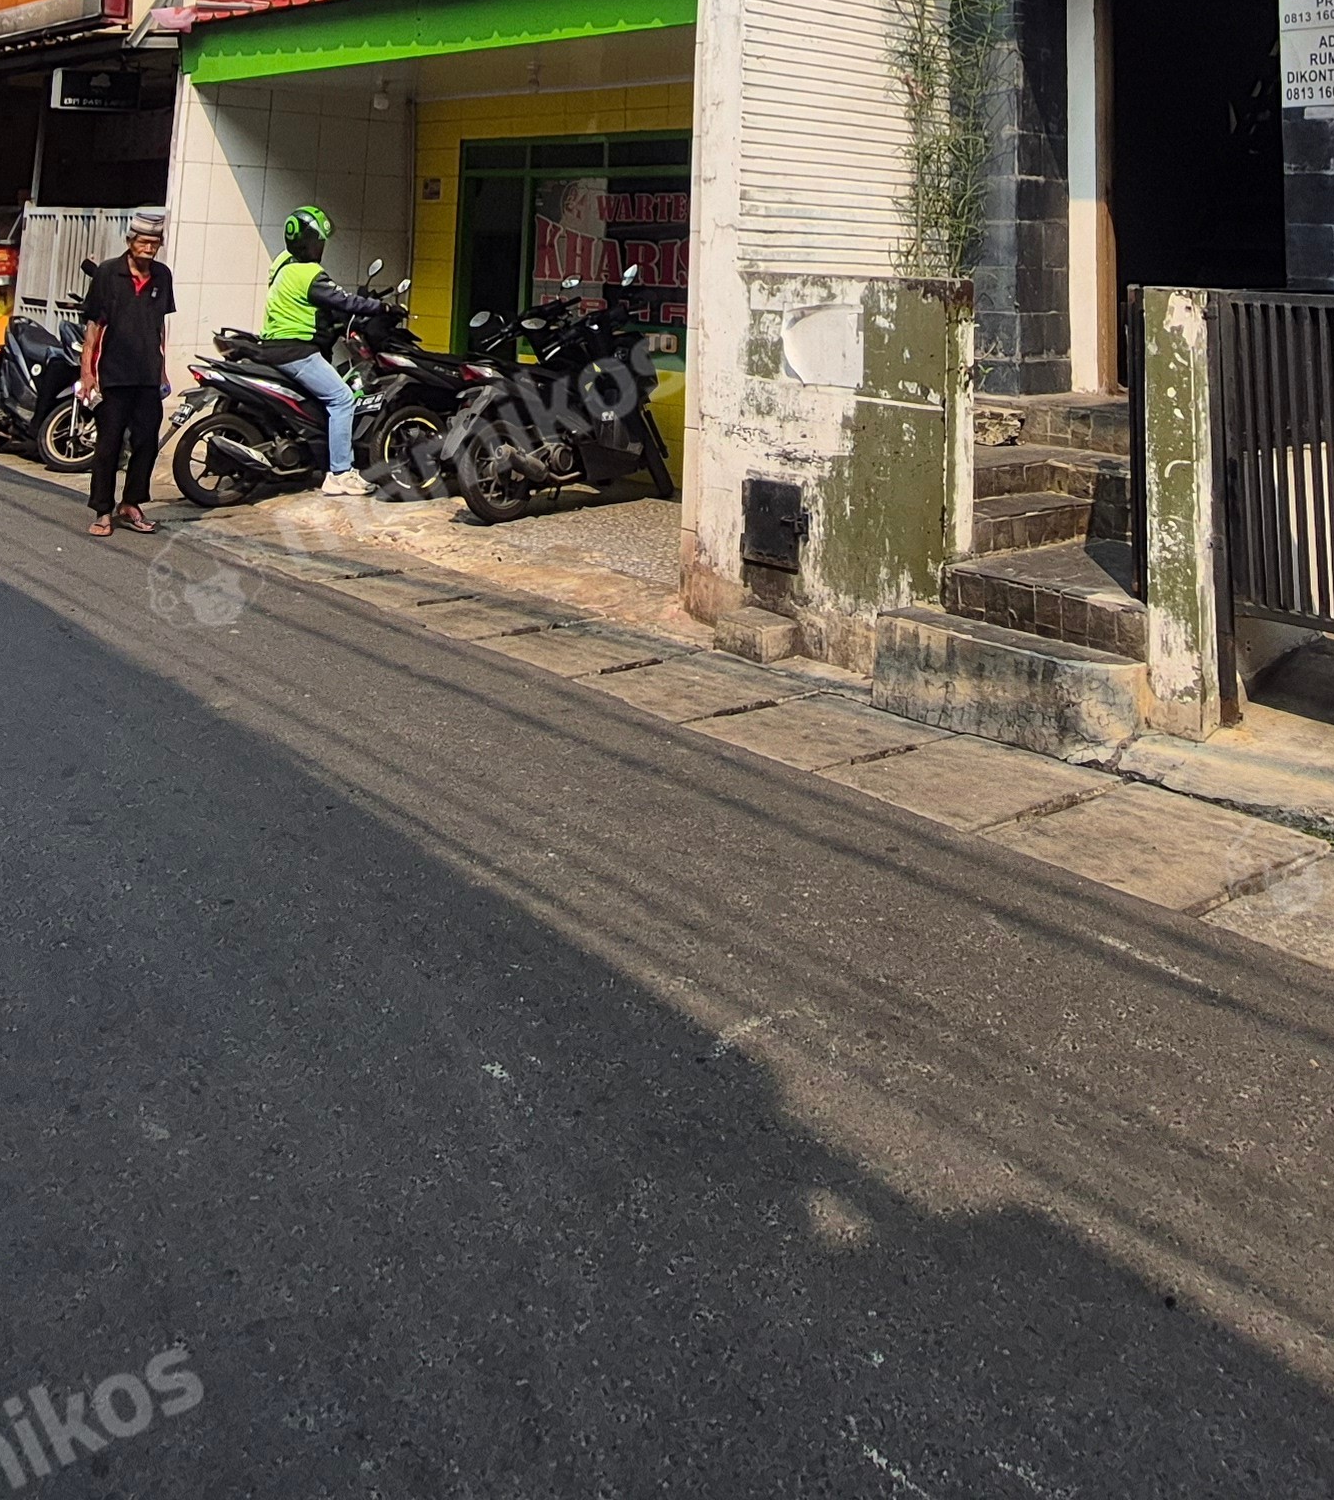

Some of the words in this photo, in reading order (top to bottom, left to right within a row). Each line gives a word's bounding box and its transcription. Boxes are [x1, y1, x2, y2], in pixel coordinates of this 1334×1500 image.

[1284, 11, 1312, 24] 0813
[1287, 87, 1314, 101] 0813
[595, 193, 690, 223] WARTE
[533, 213, 689, 288] KHARIS
